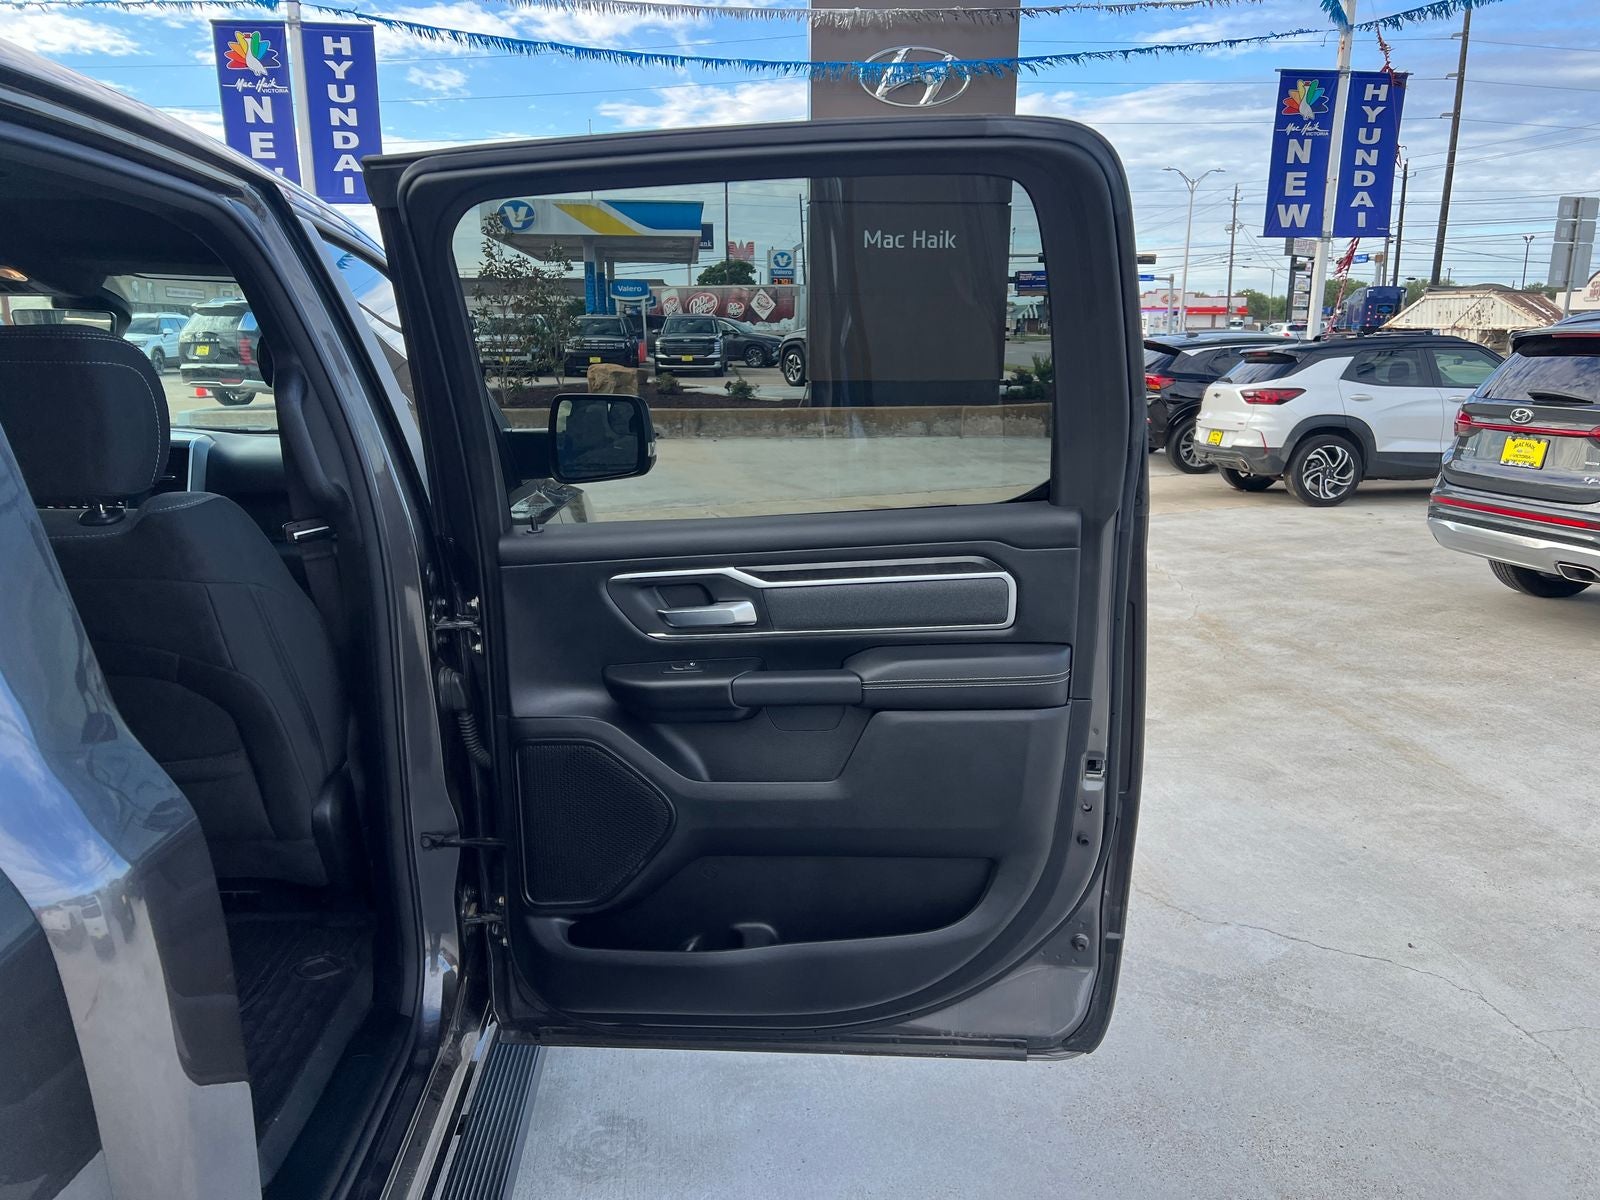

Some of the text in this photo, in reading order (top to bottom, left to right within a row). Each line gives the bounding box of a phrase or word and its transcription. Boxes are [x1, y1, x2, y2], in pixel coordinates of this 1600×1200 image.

[223, 76, 287, 93] Mac Haik
[322, 36, 363, 195] HYUNDAI
[243, 95, 284, 177] NE
[1277, 121, 1329, 136] Mac Haik
[1350, 84, 1389, 228] HYUNDAI
[1277, 138, 1312, 228] NEW
[863, 230, 958, 249] Mac Haik
